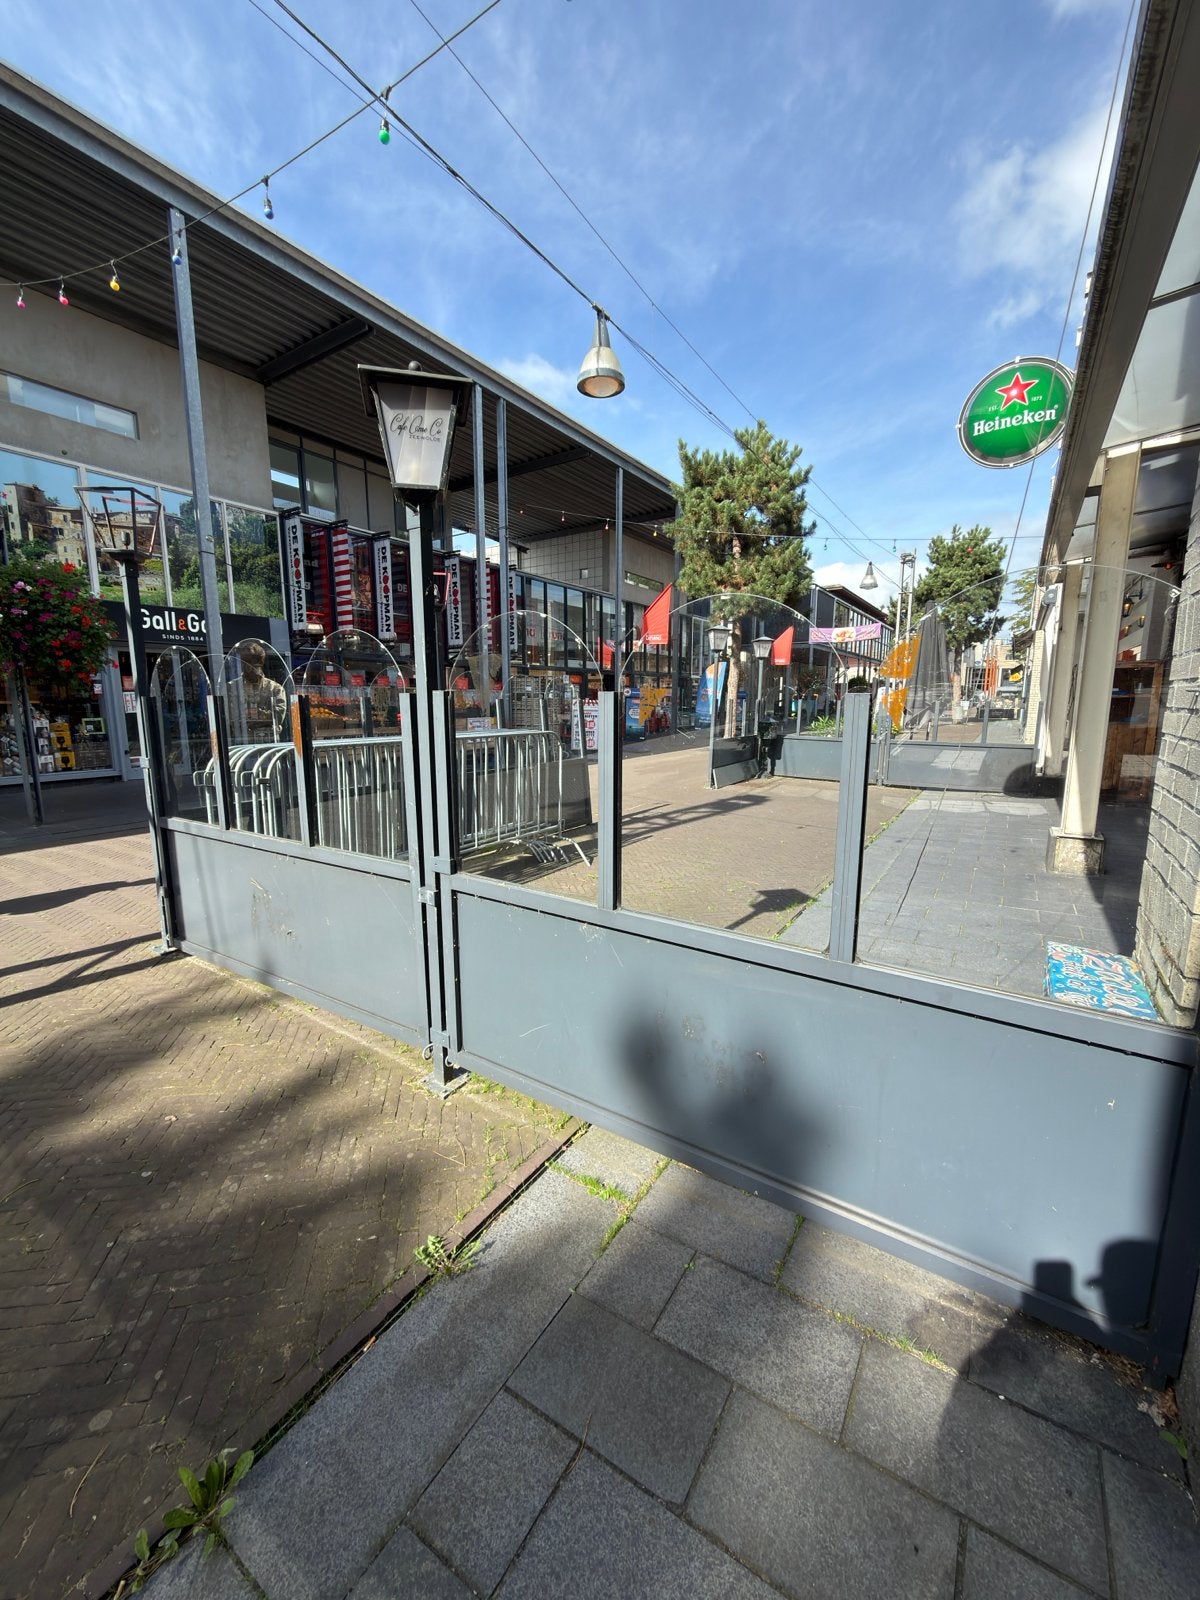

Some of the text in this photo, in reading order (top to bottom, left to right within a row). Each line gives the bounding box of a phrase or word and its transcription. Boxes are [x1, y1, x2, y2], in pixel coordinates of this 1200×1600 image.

[973, 409, 1057, 436] Heineken
[291, 524, 304, 623] DE KOOPMAN
[381, 546, 391, 632] DE KOOPMAN
[451, 563, 461, 640] DE KOOPMAN
